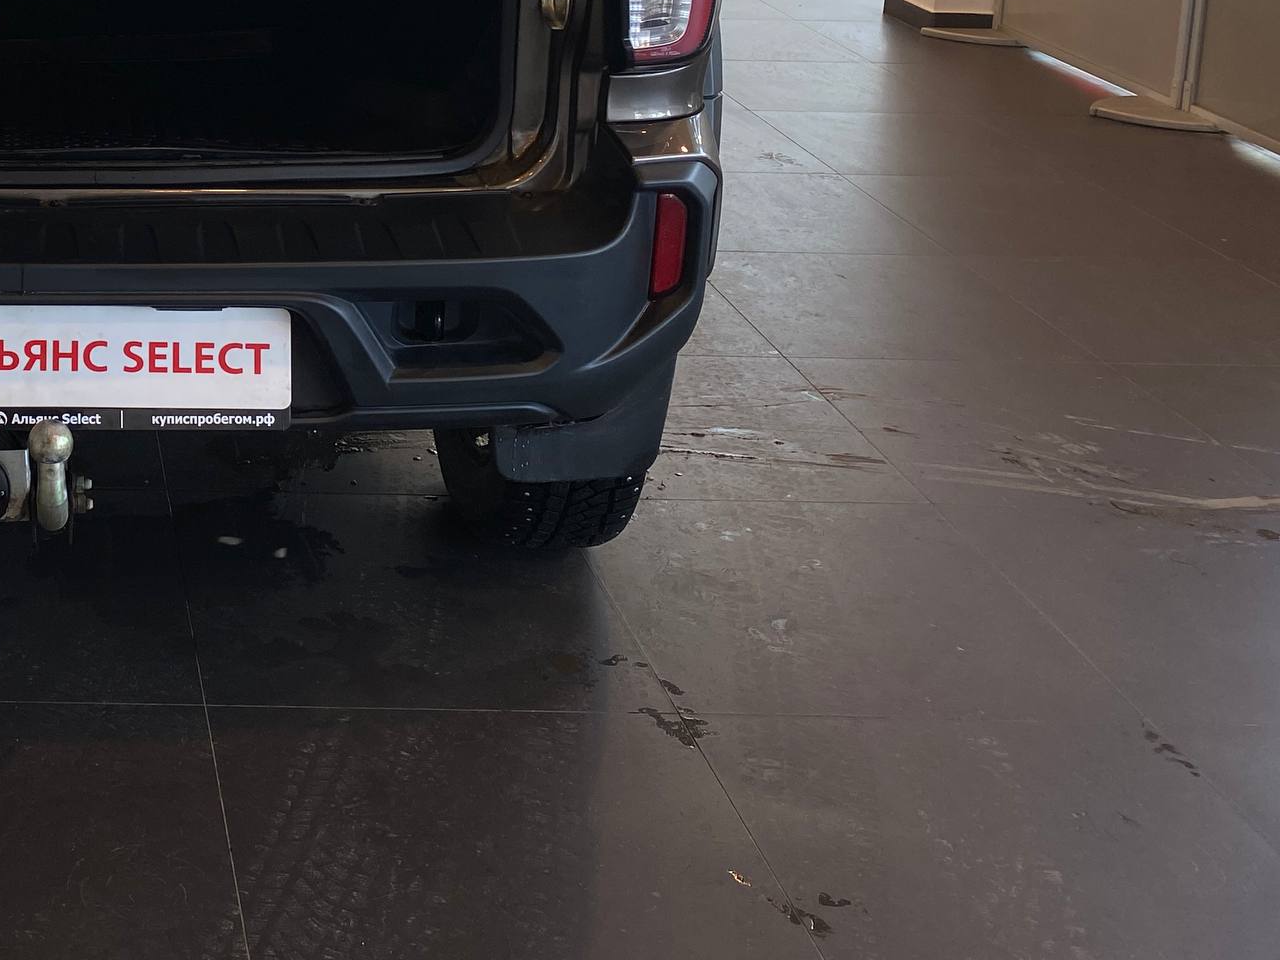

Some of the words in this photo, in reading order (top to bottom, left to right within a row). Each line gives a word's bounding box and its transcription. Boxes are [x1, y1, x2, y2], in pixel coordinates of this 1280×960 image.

[123, 341, 270, 375] SELECT
[62, 413, 102, 425] Select
[151, 413, 276, 427] куписпробегом.рф
